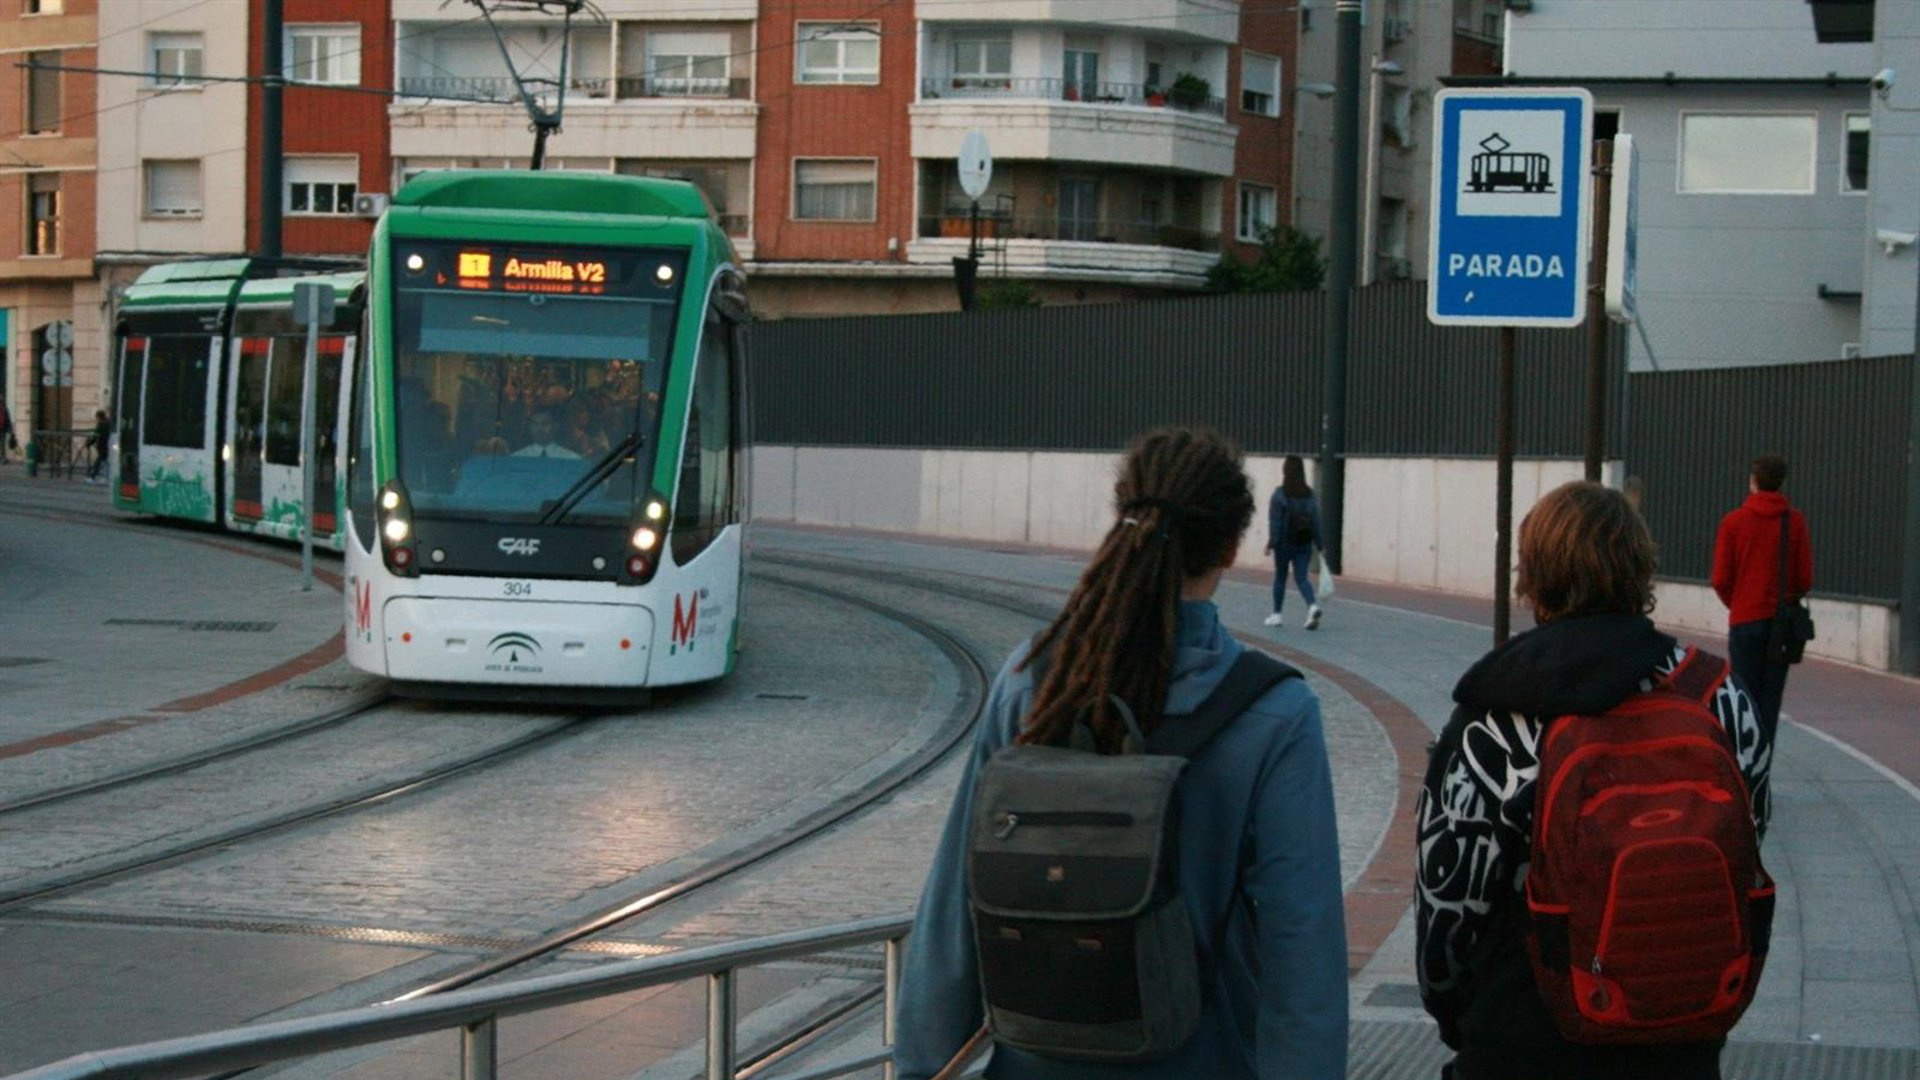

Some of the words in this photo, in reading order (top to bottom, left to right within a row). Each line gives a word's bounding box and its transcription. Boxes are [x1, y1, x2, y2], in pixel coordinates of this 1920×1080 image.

[505, 258, 574, 280] Armilla
[577, 262, 605, 282] V2
[1449, 253, 1564, 278] PARADA
[498, 537, 541, 555] CAF
[503, 581, 531, 596] 304
[355, 576, 371, 643] M
[670, 590, 698, 656] M
